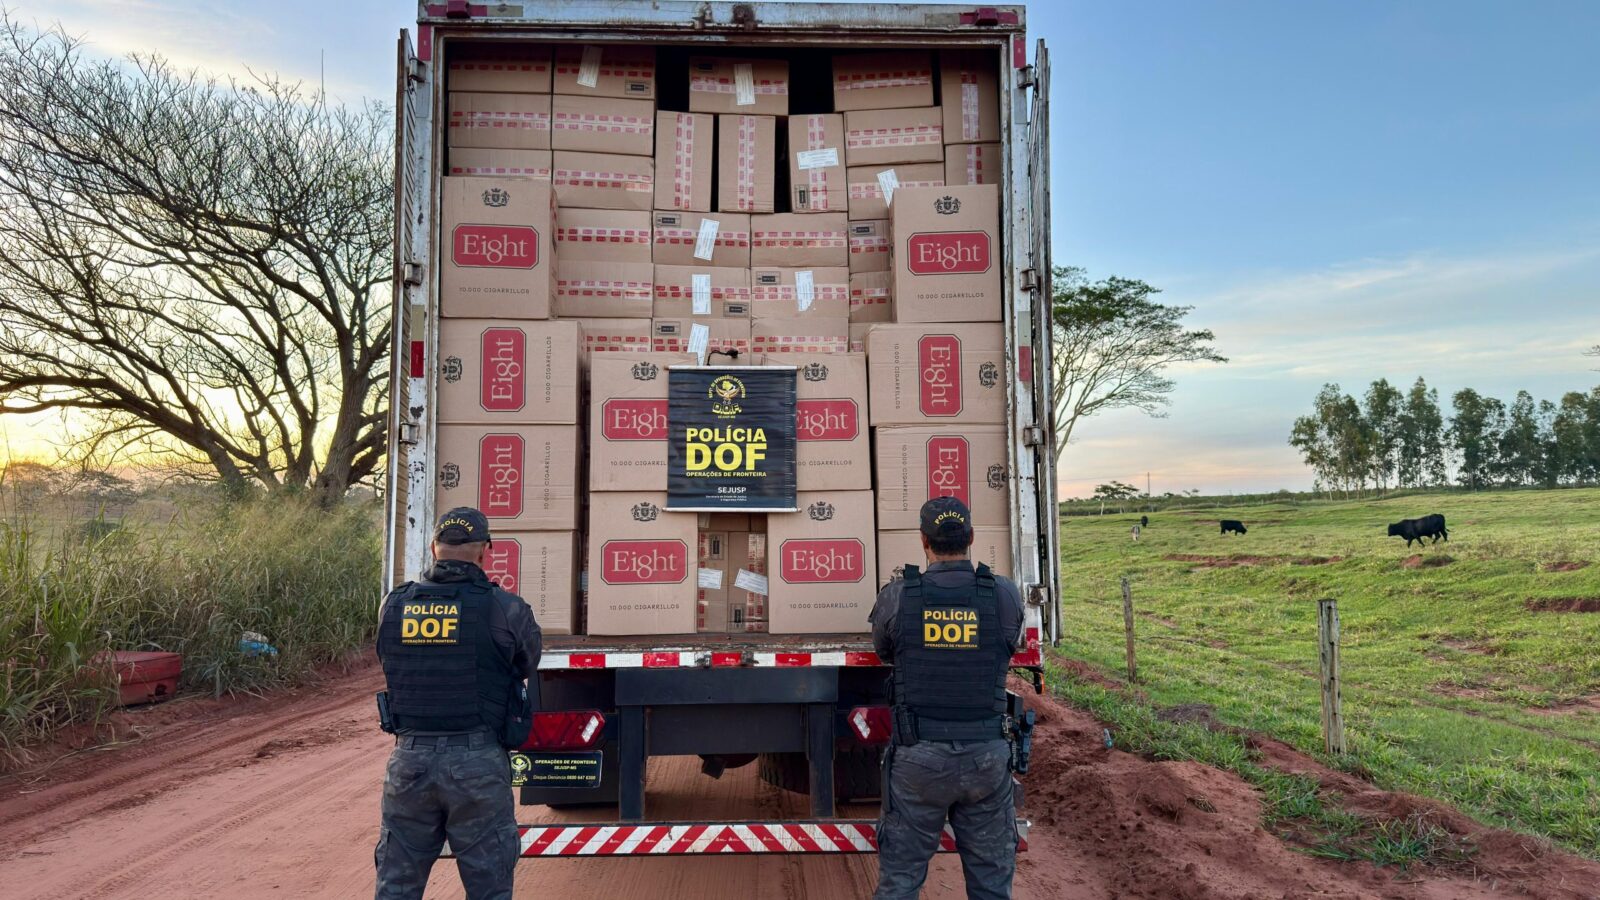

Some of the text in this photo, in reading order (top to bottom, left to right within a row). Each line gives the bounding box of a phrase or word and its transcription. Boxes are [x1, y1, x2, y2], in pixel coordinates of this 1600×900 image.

[461, 233, 528, 264] Eight
[917, 240, 982, 270] Eight
[490, 337, 521, 402] Eight
[924, 343, 953, 407] Eight
[611, 407, 669, 437] Eigh
[686, 425, 767, 442] POLÍCIA
[686, 442, 767, 471] DOF
[488, 443, 519, 509] Eight
[932, 446, 961, 498] Eigh
[440, 517, 474, 532] POLÍCIA
[934, 510, 965, 525] POLÍCIA
[485, 549, 515, 591] ght
[611, 548, 678, 580] Eight
[790, 547, 856, 579] Eight
[403, 602, 459, 615] POLÍCIA
[924, 608, 977, 621] POLÍCIA
[402, 618, 458, 638] DOF
[924, 623, 978, 643] DOF
